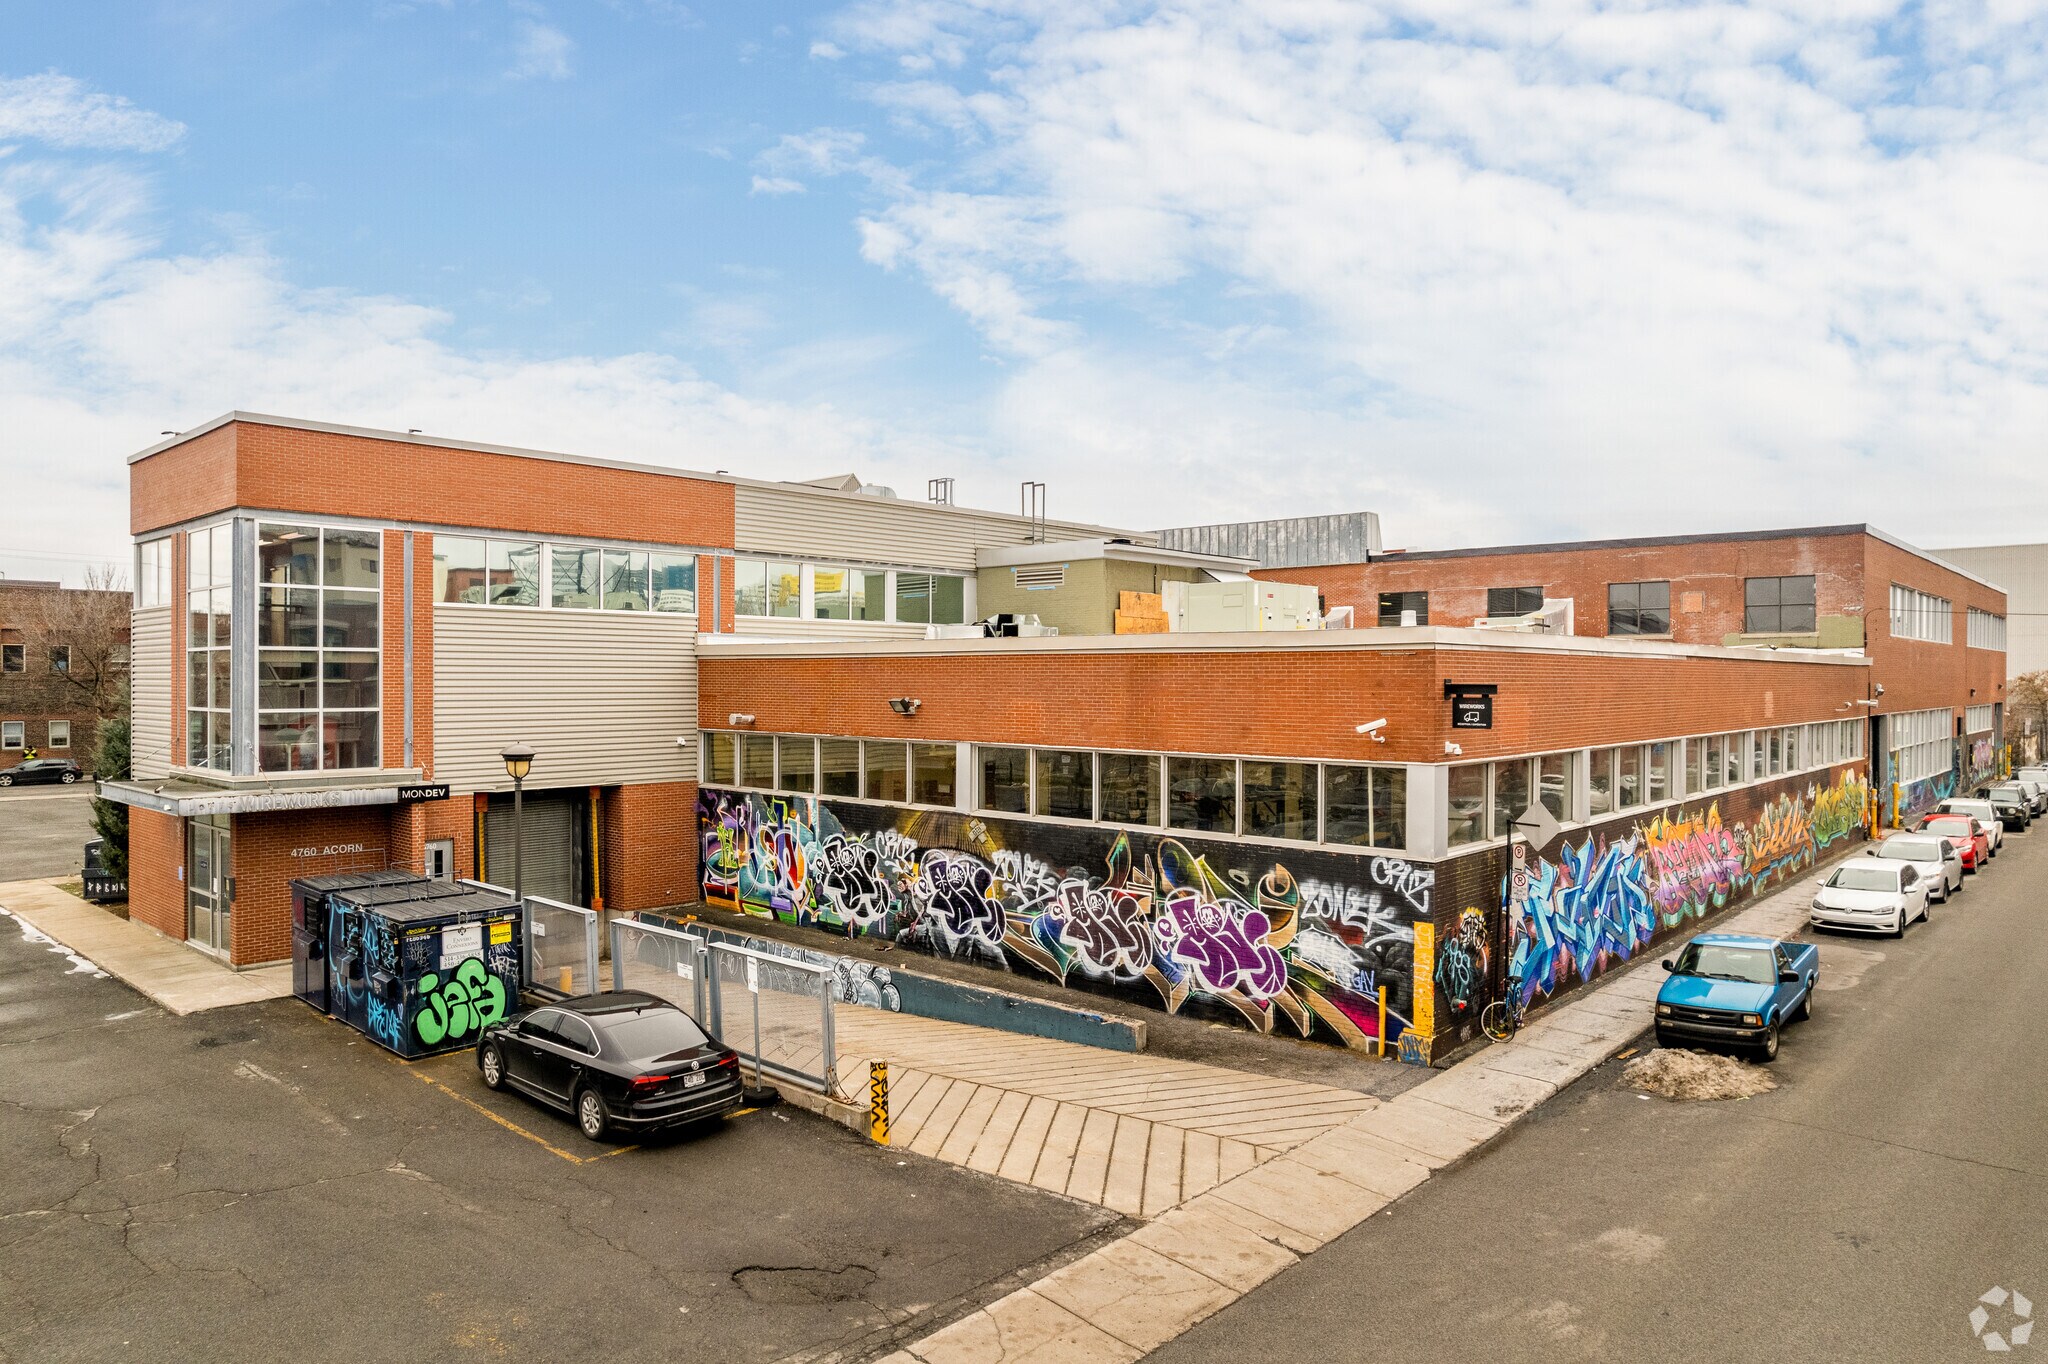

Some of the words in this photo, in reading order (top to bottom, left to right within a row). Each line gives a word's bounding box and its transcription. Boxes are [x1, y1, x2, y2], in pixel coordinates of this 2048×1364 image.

[401, 788, 446, 799] MONDEV
[240, 791, 342, 812] WIREWORKS
[290, 847, 317, 858] 4760
[322, 843, 363, 855] ACORN
